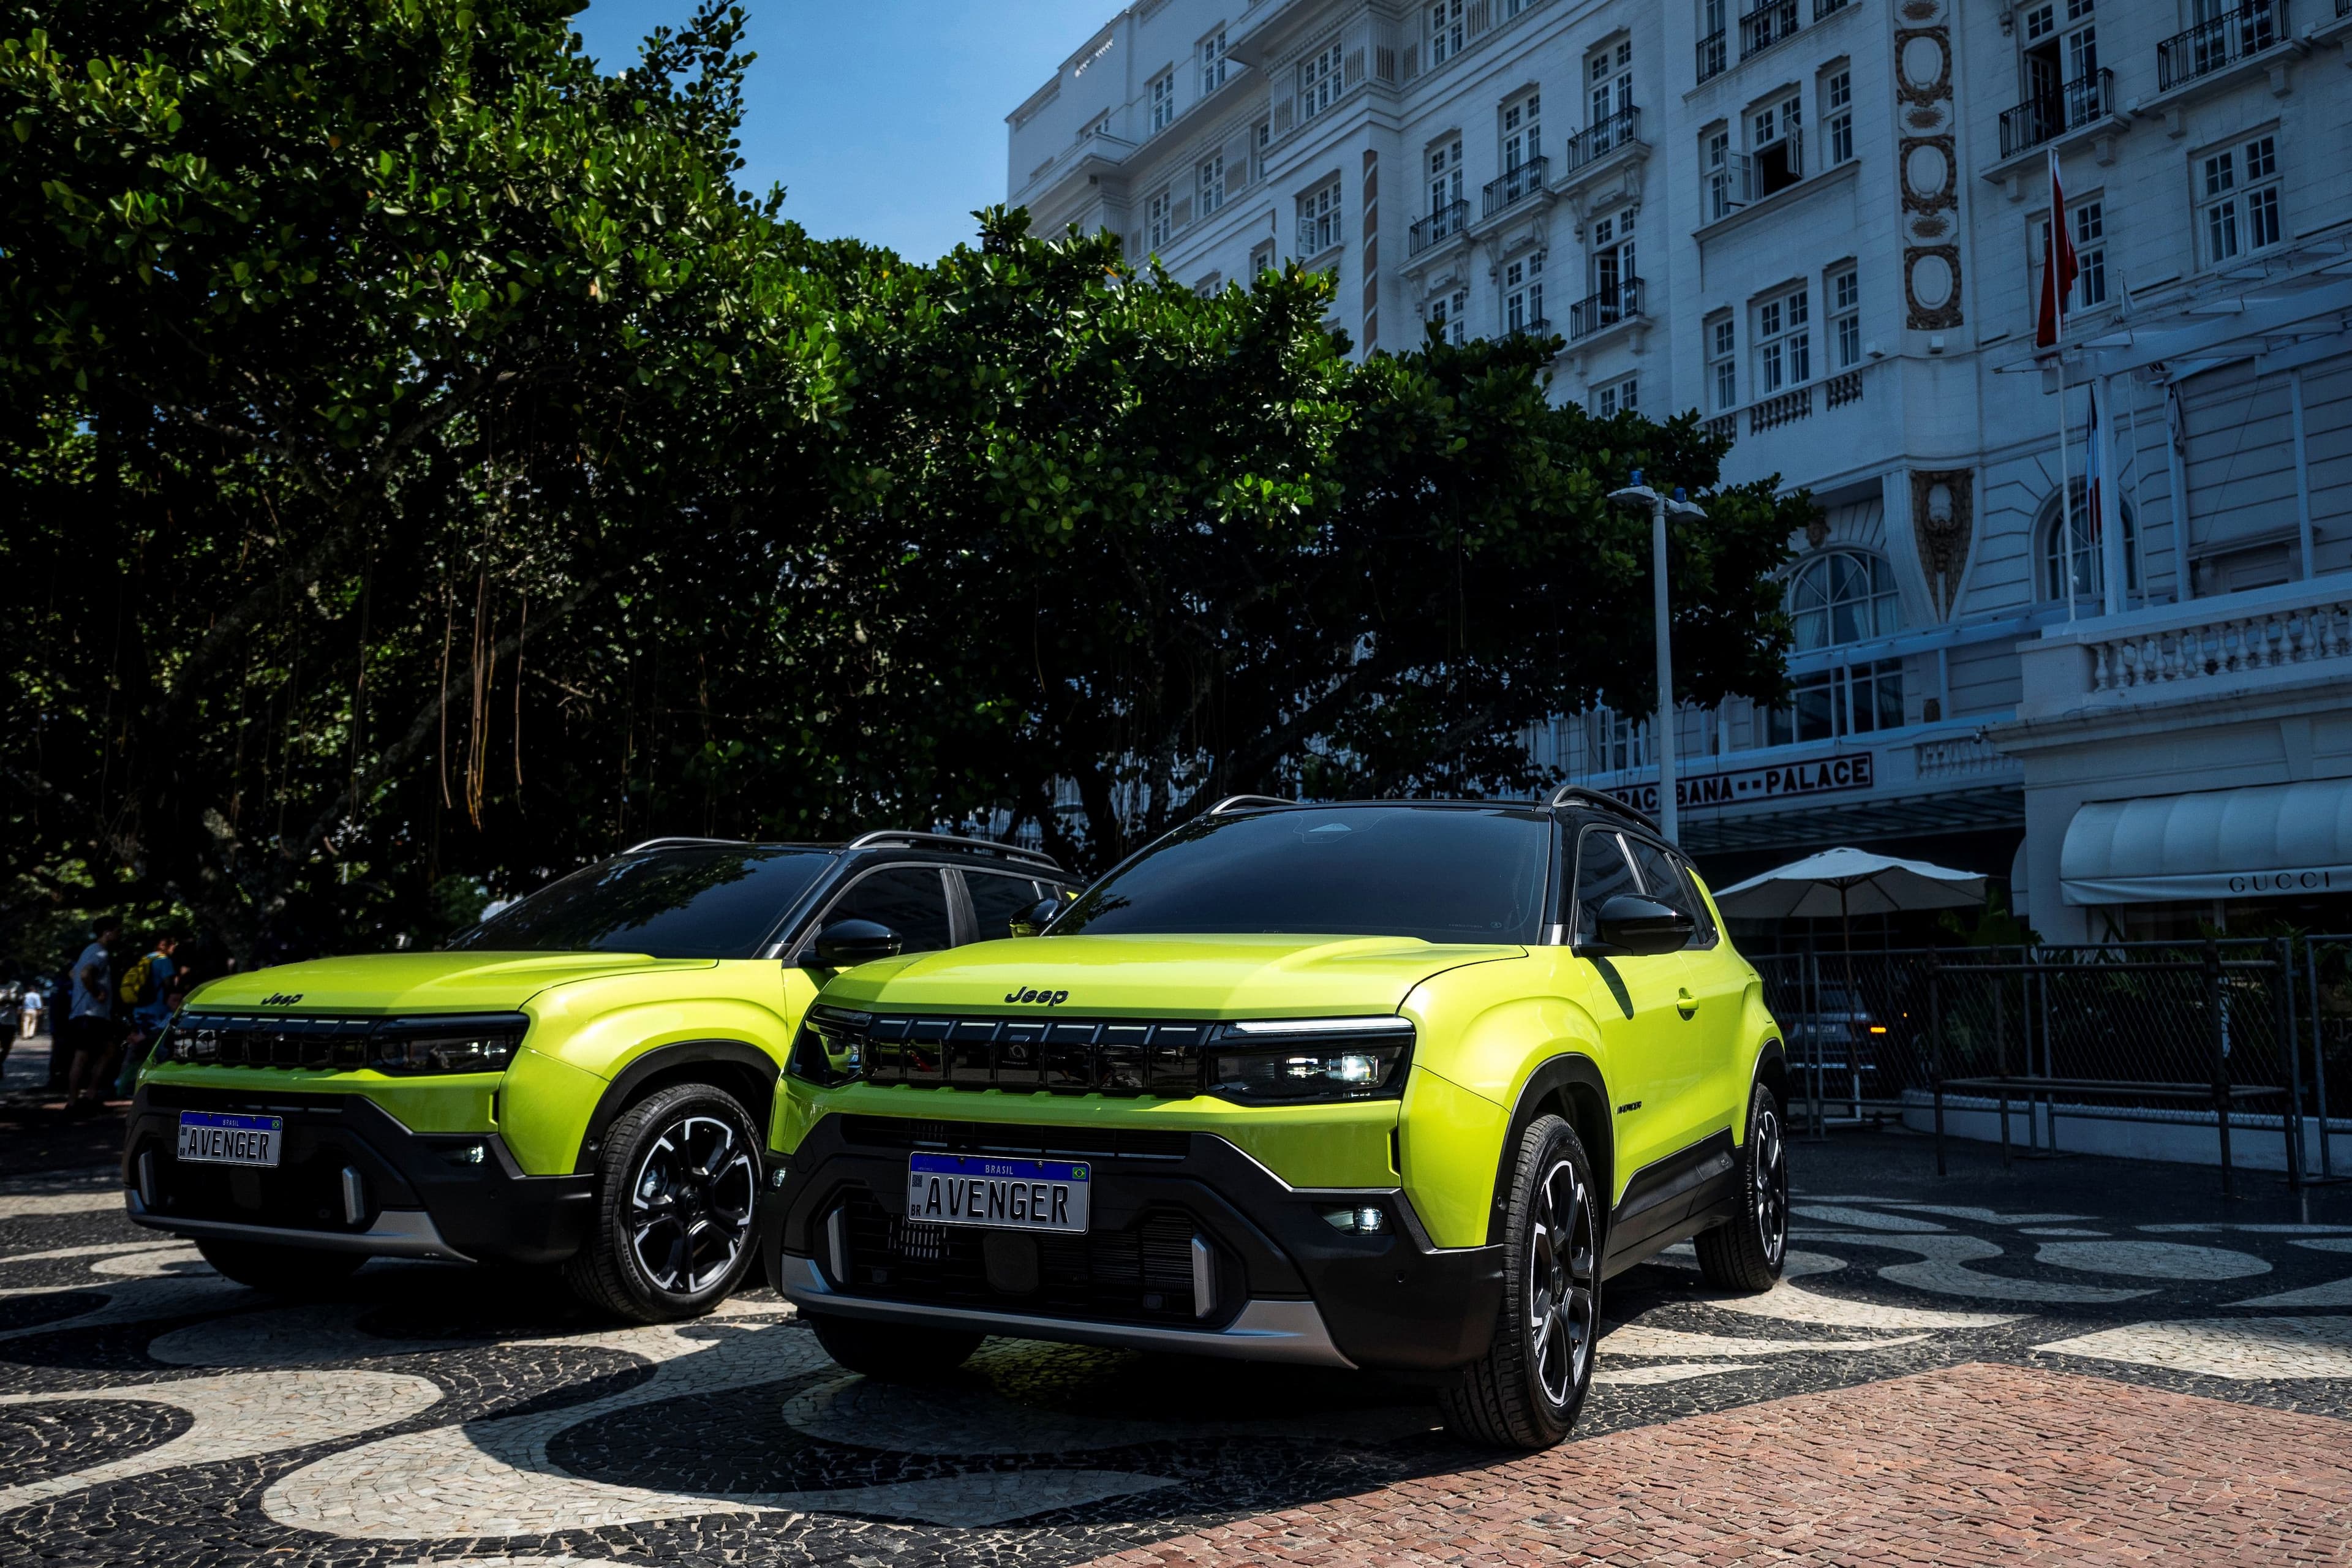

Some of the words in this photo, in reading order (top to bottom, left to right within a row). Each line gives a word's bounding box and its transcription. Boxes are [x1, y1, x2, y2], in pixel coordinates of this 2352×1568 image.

[1608, 777, 1733, 810] PACBANA
[1766, 758, 1868, 794] PALACE
[2229, 871, 2330, 893] GUCCI
[260, 992, 304, 1007] Jeep
[1005, 986, 1069, 1007] Jeep
[188, 1128, 270, 1161] AVENGER
[985, 1164, 1014, 1175] BRASIL
[911, 1204, 921, 1216] BR
[925, 1176, 1069, 1224] AVENGER
